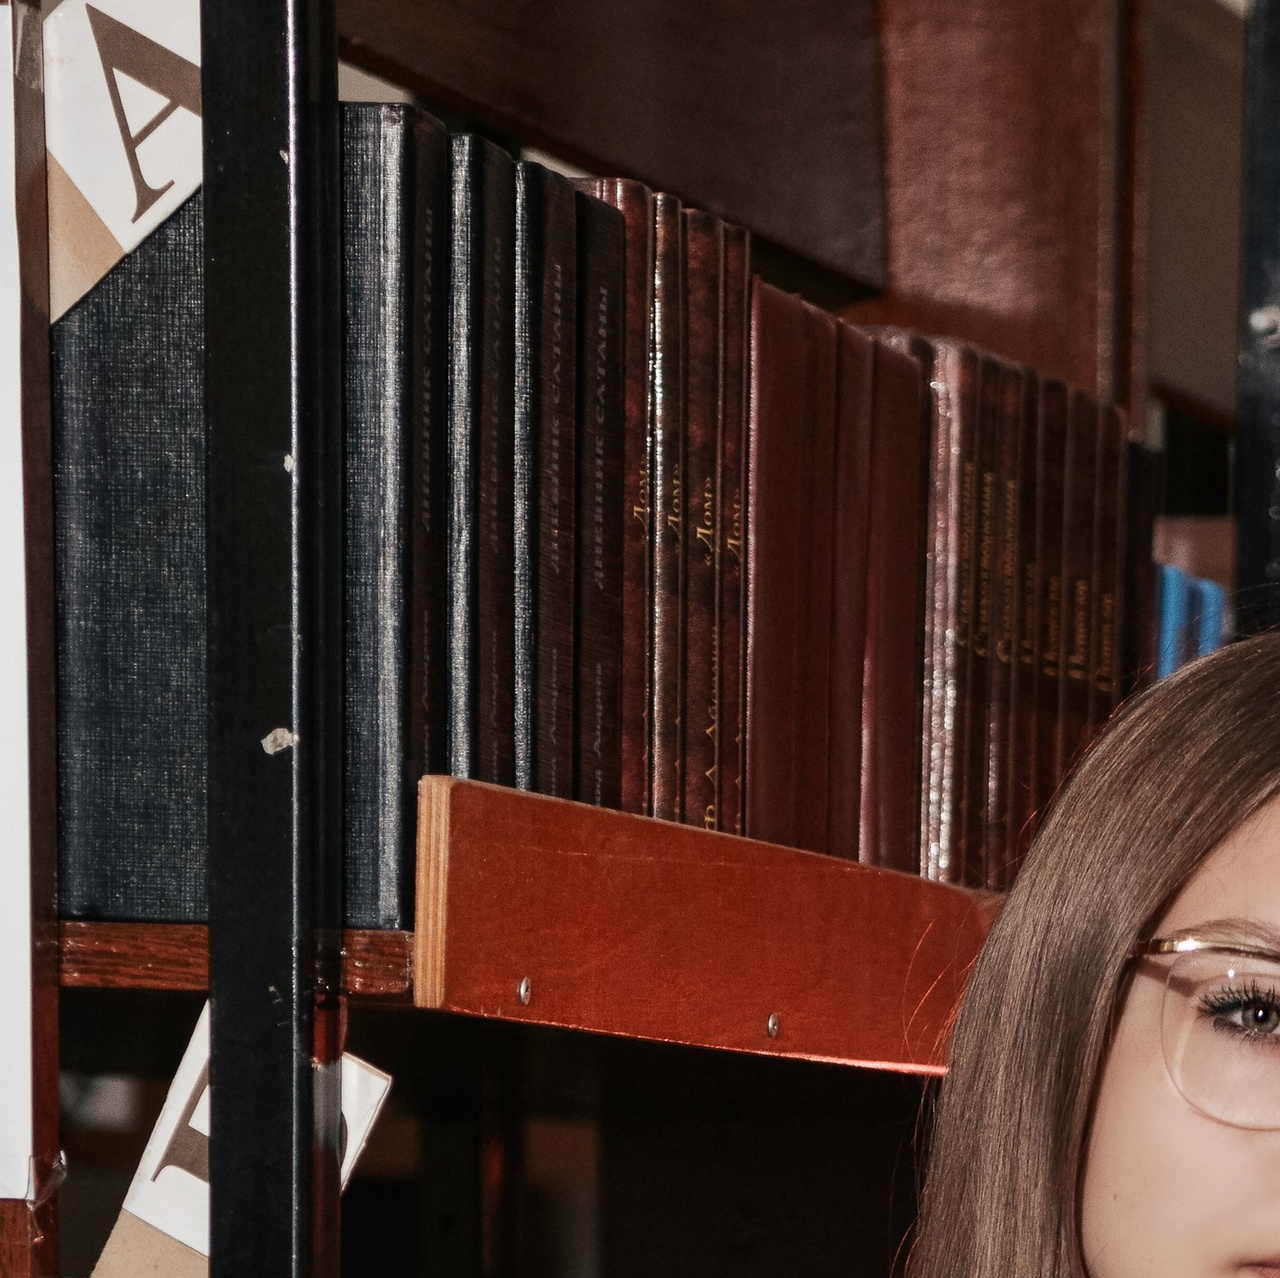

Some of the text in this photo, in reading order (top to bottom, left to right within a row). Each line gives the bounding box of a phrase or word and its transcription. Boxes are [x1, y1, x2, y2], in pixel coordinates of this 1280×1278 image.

[594, 287, 608, 591] ДНЕВНИК САТАНЫ
[696, 477, 714, 566] «Дом»
